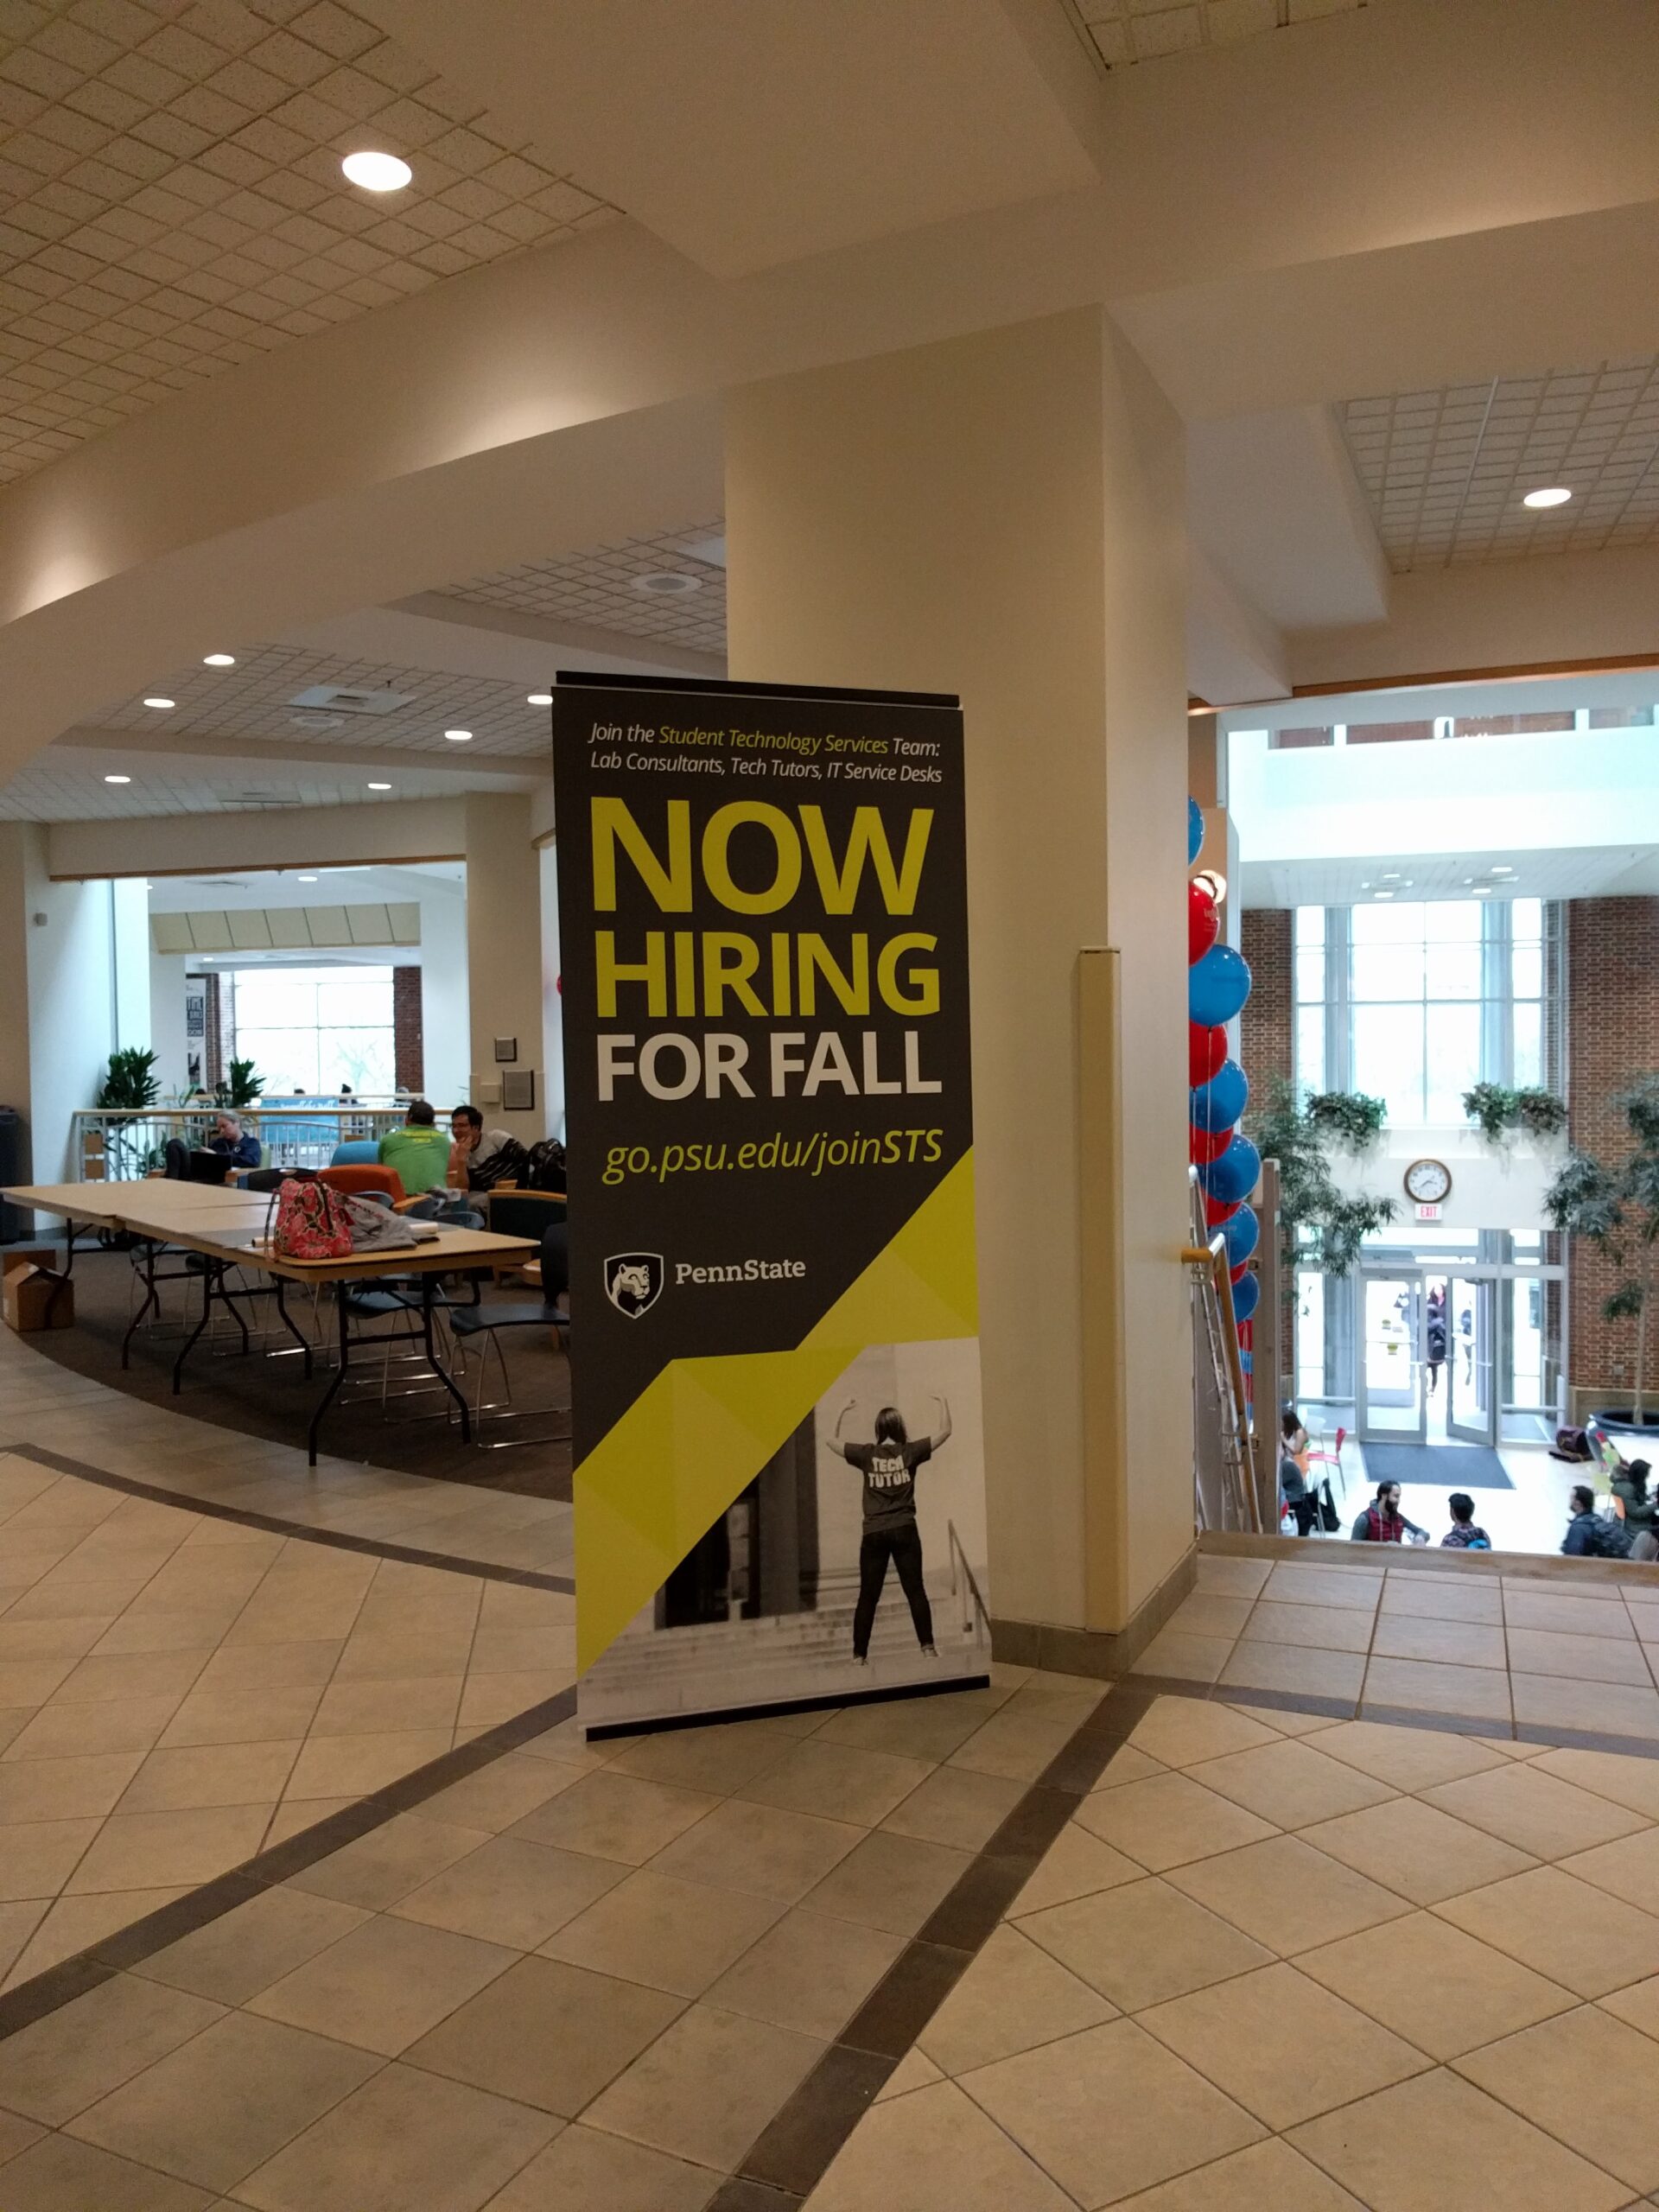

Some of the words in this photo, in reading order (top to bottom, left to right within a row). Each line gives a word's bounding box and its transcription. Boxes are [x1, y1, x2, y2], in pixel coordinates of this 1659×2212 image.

[588, 722, 622, 744] Join
[627, 724, 655, 743] the
[658, 726, 724, 747] Student
[729, 729, 822, 756] Technology
[824, 734, 889, 754] Services
[893, 738, 941, 757] Team:
[590, 751, 622, 769] Lab
[626, 753, 726, 776] Consultants,
[731, 757, 767, 775] Tech
[772, 760, 823, 780] Tutors,
[827, 762, 843, 779] IT
[844, 762, 897, 781] Service
[899, 766, 943, 783] Desks
[590, 797, 935, 916] NOW
[594, 931, 940, 1018] HIRING
[596, 1033, 756, 1102] FOR
[770, 1030, 943, 1097] FALL
[601, 1128, 944, 1185] go.psu.edu/joinSTS
[1420, 1205, 1438, 1217] EXIT
[868, 1469, 911, 1488] TUTOR
[872, 1455, 905, 1472] TECH
